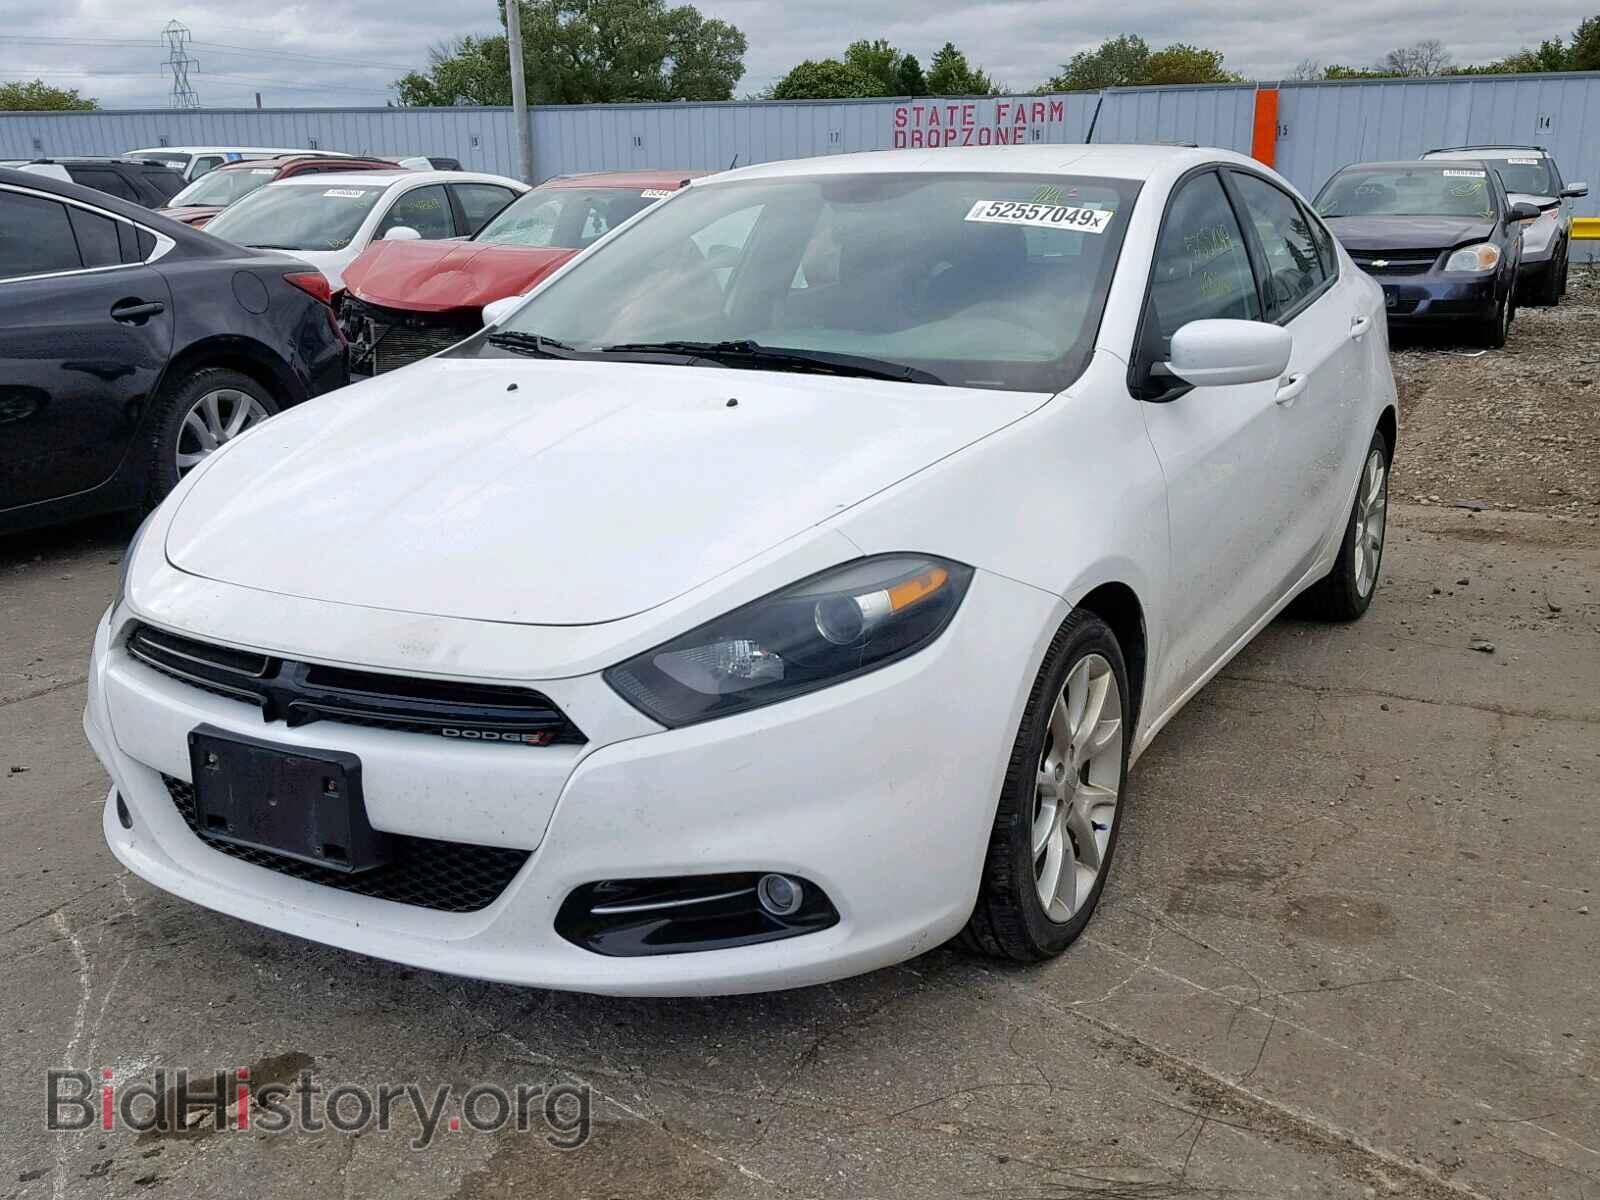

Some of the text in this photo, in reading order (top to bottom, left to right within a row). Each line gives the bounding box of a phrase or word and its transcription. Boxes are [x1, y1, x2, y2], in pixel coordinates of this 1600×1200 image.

[895, 101, 1064, 128] STATE FARM
[1540, 117, 1550, 129] 14
[894, 126, 1027, 149] DROPZONE
[1031, 129, 1041, 141] 16
[1277, 124, 1289, 137] 15
[442, 727, 540, 743] DODGE
